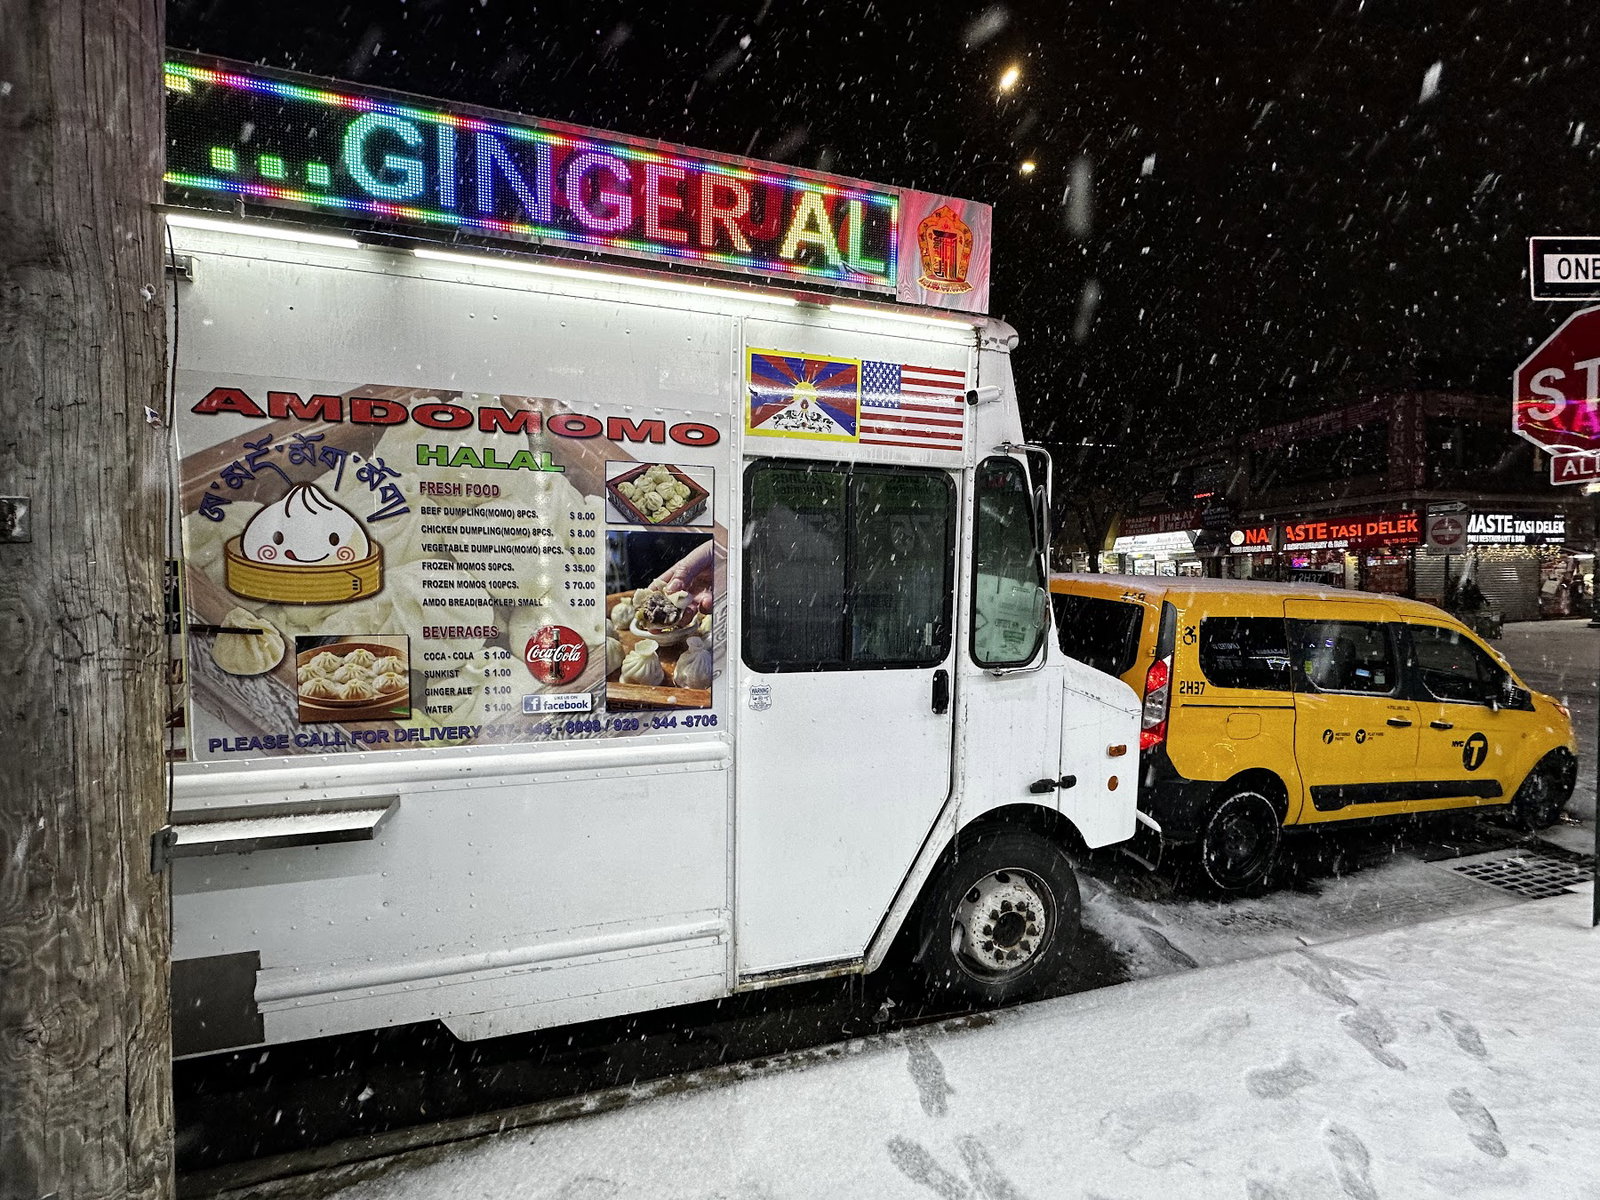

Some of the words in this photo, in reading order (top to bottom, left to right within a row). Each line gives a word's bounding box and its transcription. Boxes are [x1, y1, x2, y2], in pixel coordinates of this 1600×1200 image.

[779, 192, 886, 273] AL
[1558, 257, 1600, 280] ONE
[191, 387, 721, 446] AMDOMOMO
[416, 444, 566, 473] HALAL
[420, 481, 462, 496] FRESH
[466, 483, 500, 498] FOOD
[421, 506, 441, 516] BEEF
[444, 507, 515, 519] DUMPLING(MOMO)
[570, 512, 575, 520] $
[578, 512, 595, 520] 8.00
[421, 525, 458, 534] CHICKEN
[460, 526, 530, 538] DUMPLING(MOMO)
[570, 529, 575, 538] $
[578, 530, 595, 538] 8.00
[1330, 524, 1362, 538] TASI
[1366, 518, 1418, 536] DELEK
[1514, 520, 1534, 534] TASI
[1536, 520, 1565, 534] DELEK
[421, 544, 468, 552] VEGETABLE
[471, 544, 540, 555] DUMPLING(MOMO)
[570, 546, 575, 555] $
[578, 547, 595, 555] 8.00
[422, 562, 454, 571] FROZEN
[456, 562, 486, 571] MOMOS
[488, 562, 514, 572] 50PCS.
[564, 564, 570, 572] $
[422, 580, 454, 588] FROZEN
[457, 580, 486, 588] MOMOS
[488, 580, 519, 589] 100PCS.
[564, 581, 570, 590] $
[572, 582, 595, 590] 70.00
[422, 598, 446, 606] AMDO
[448, 598, 516, 608] BREAD(BACKLEP)
[518, 598, 543, 606] SMALL
[570, 598, 576, 606] $
[578, 598, 596, 606] 2.00
[422, 626, 499, 639] BEVERAGES
[424, 652, 446, 660] COCA
[452, 652, 474, 660] COLA
[484, 652, 490, 660] $
[492, 651, 511, 660] 1.00
[424, 670, 460, 678] SUNKIST
[484, 668, 490, 677] $
[492, 668, 511, 677] 1.00
[424, 688, 454, 696] GINGER
[458, 687, 472, 695] ALE
[484, 686, 490, 694] $
[492, 686, 511, 694] 1.00
[1180, 680, 1206, 696] 2H37
[424, 706, 453, 714] WATER
[484, 704, 490, 712] $
[492, 703, 512, 712] 1.00
[544, 700, 588, 710] facebook
[208, 734, 289, 753] PLEASE
[294, 732, 346, 749] CALL
[352, 729, 391, 745] FOR
[394, 725, 482, 742] DELIVERY
[614, 718, 640, 732] 929
[652, 716, 678, 730] 344
